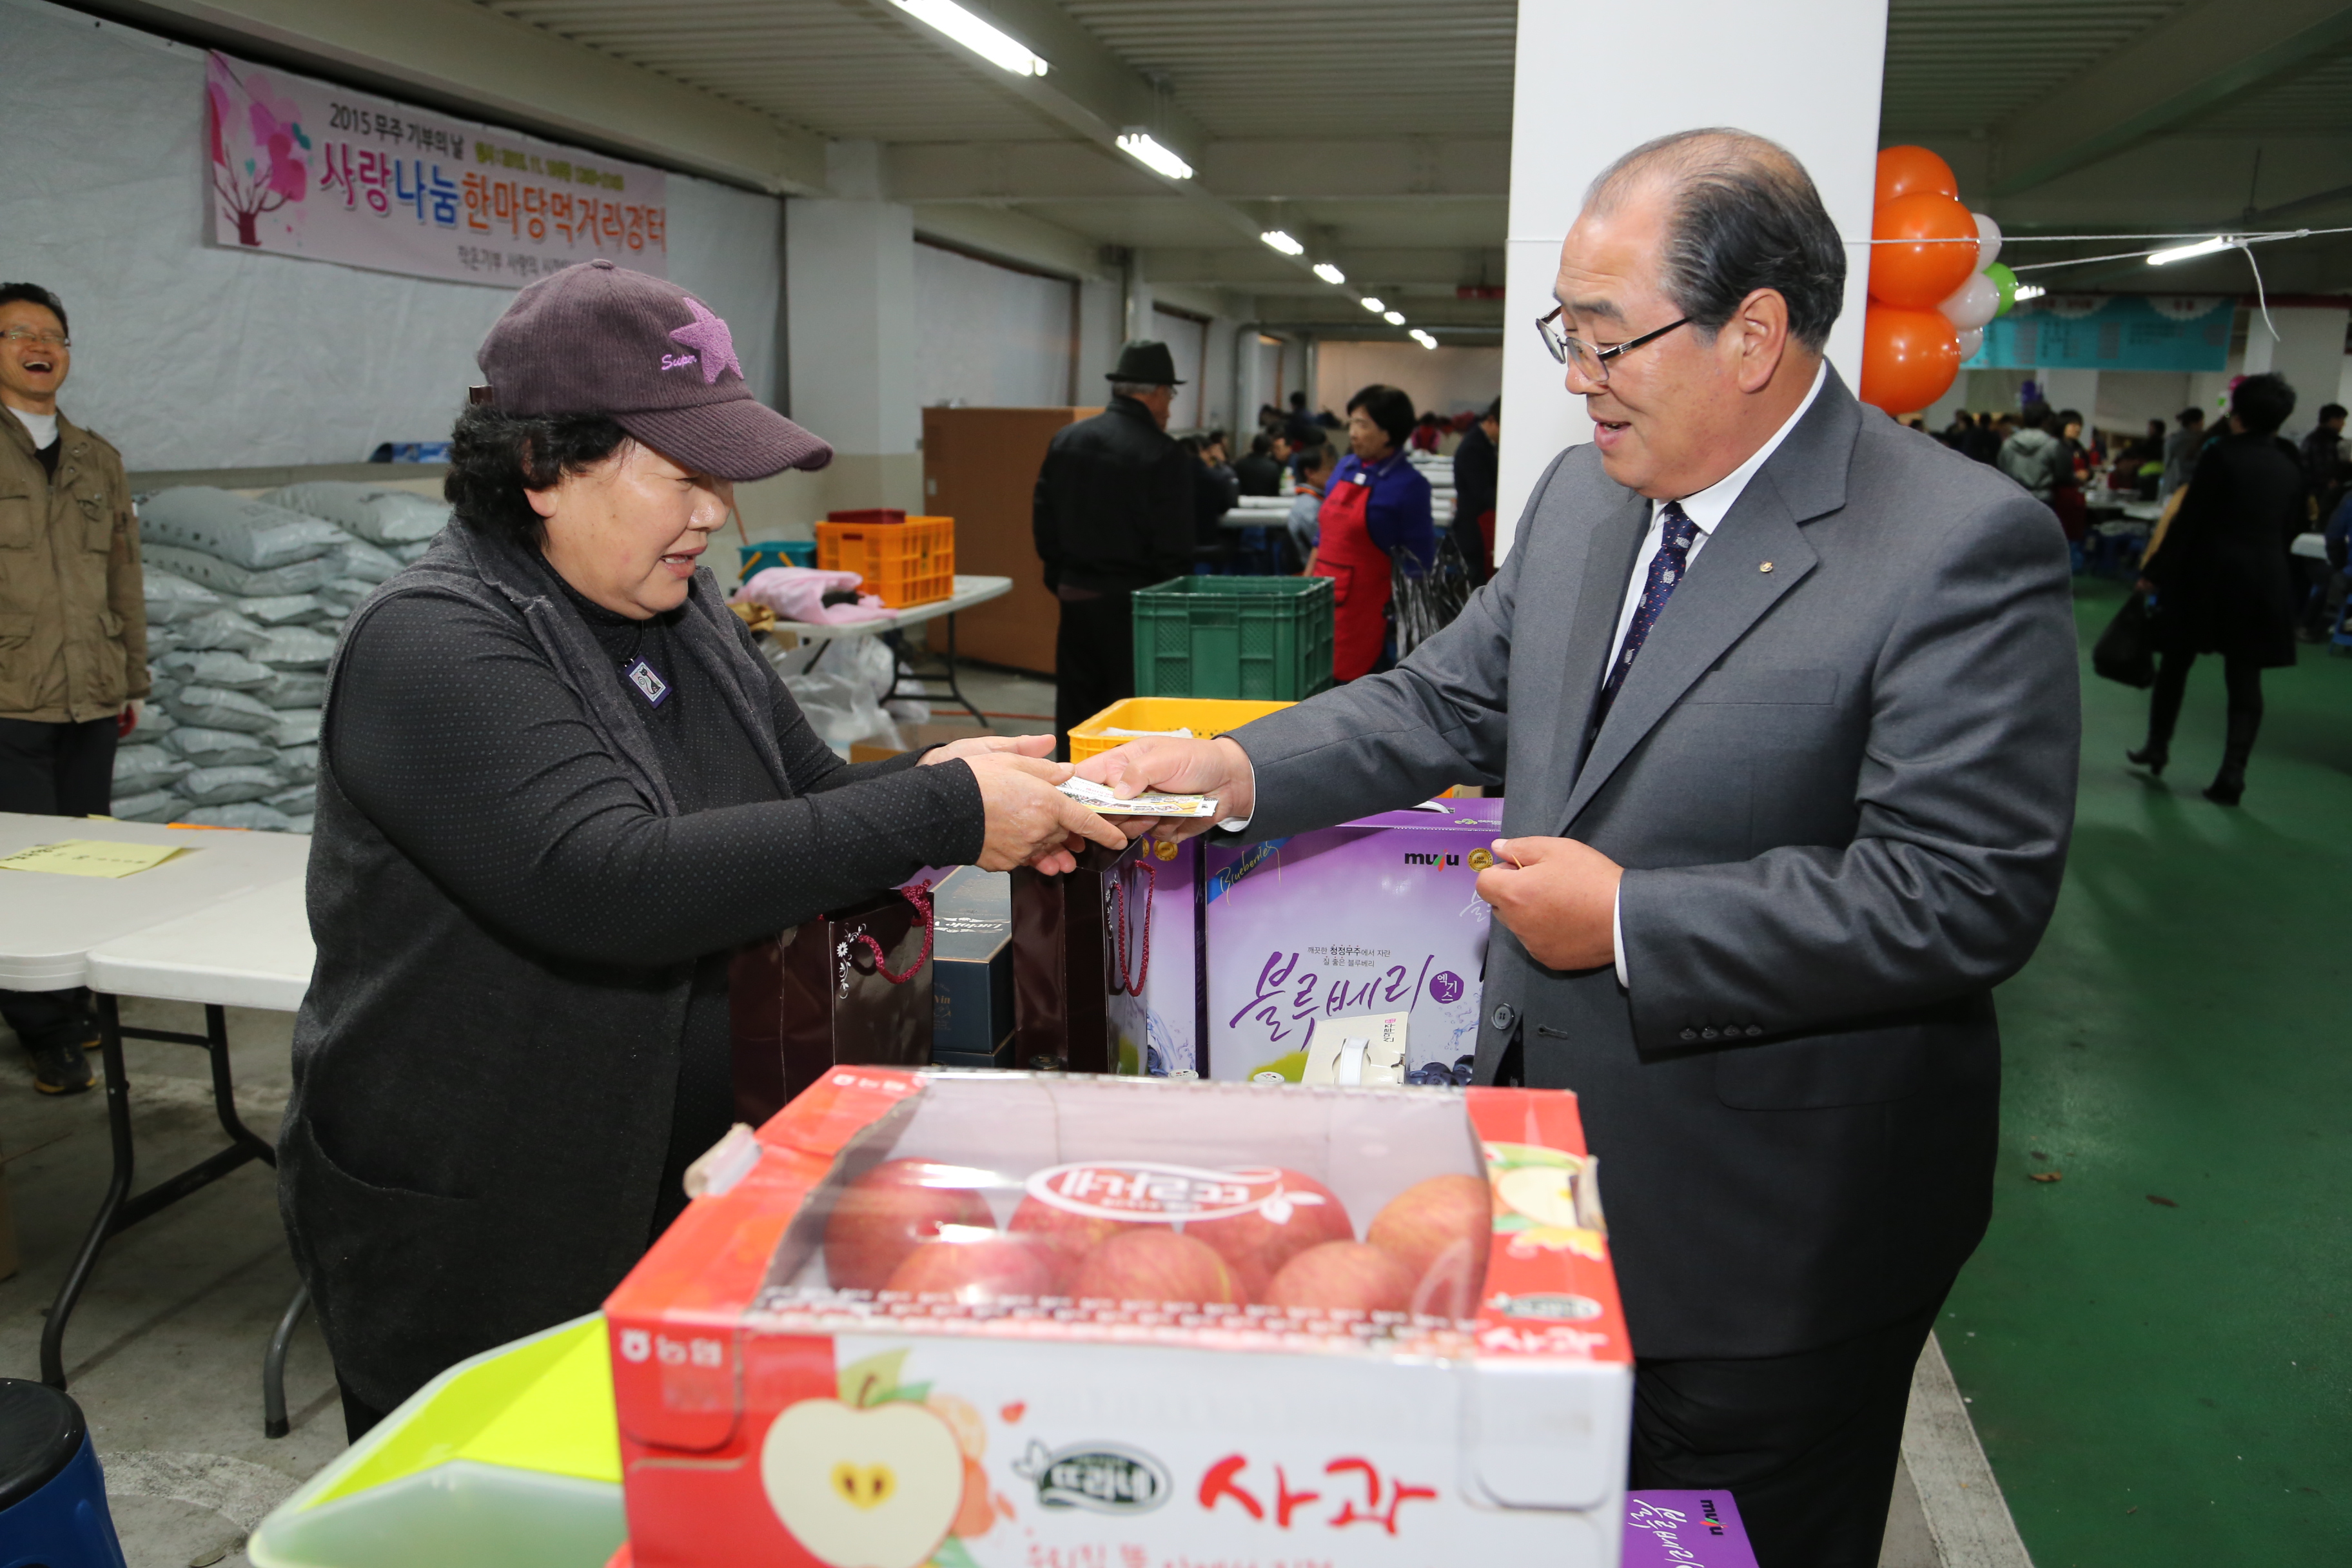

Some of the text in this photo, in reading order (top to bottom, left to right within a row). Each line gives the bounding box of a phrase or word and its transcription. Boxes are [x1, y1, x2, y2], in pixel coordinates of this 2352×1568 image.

[330, 103, 371, 135] 2015
[375, 113, 404, 146] 무주
[1329, 946, 1375, 957] 청정무주에서
[1230, 951, 1434, 1052] 블루베리
[1437, 973, 1458, 1001] 엑기스
[1383, 1023, 1396, 1043] 산머루주
[1198, 1454, 1438, 1535] 사과
